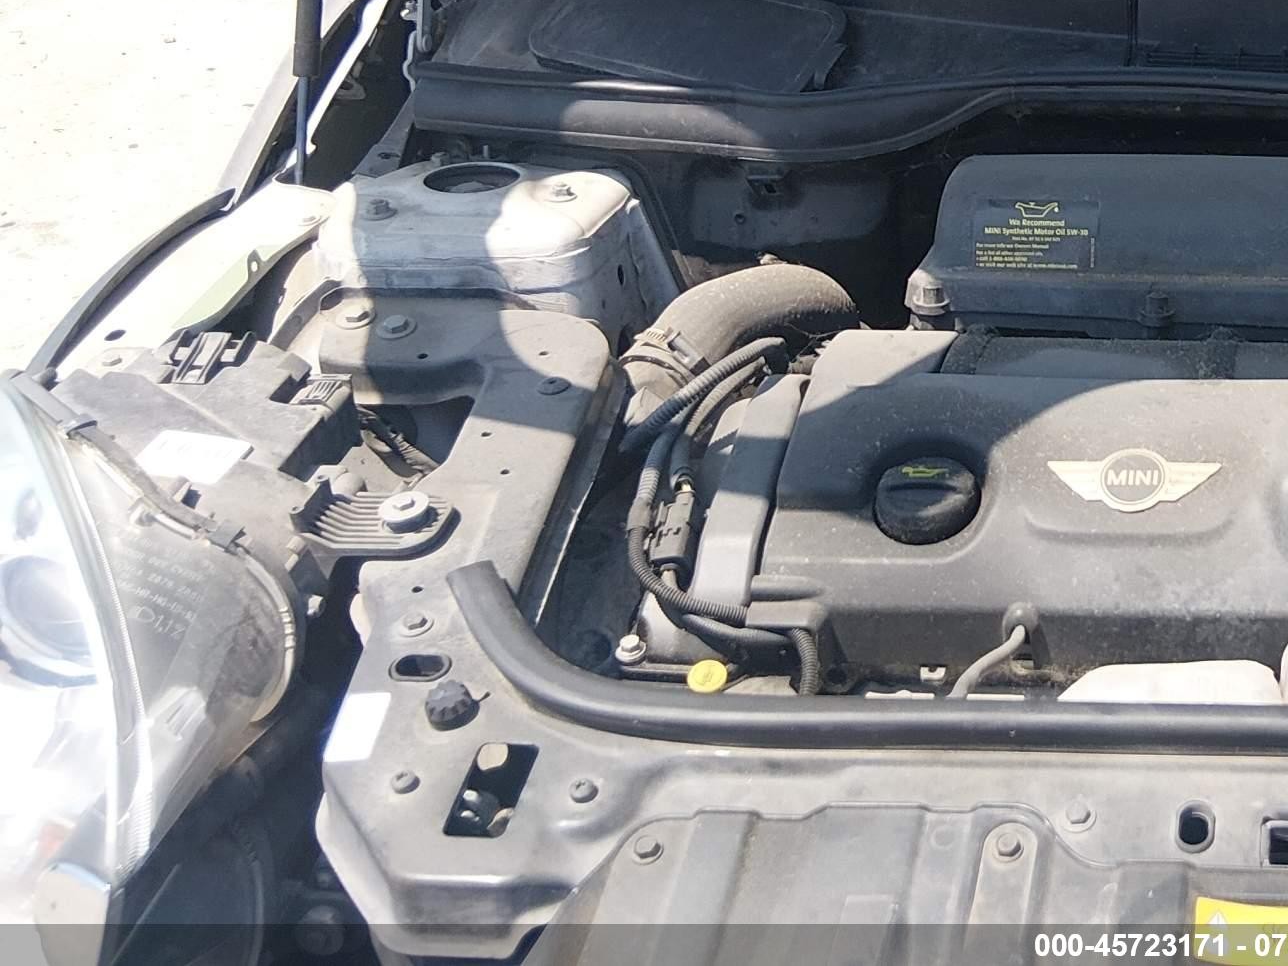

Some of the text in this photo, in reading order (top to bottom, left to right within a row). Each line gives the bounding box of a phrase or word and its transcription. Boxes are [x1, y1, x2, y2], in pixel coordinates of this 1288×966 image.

[1021, 218, 1065, 227] Recommend
[984, 226, 1089, 236] MINI Synthetic Motor Oil 5W-30
[1107, 469, 1159, 486] MINI
